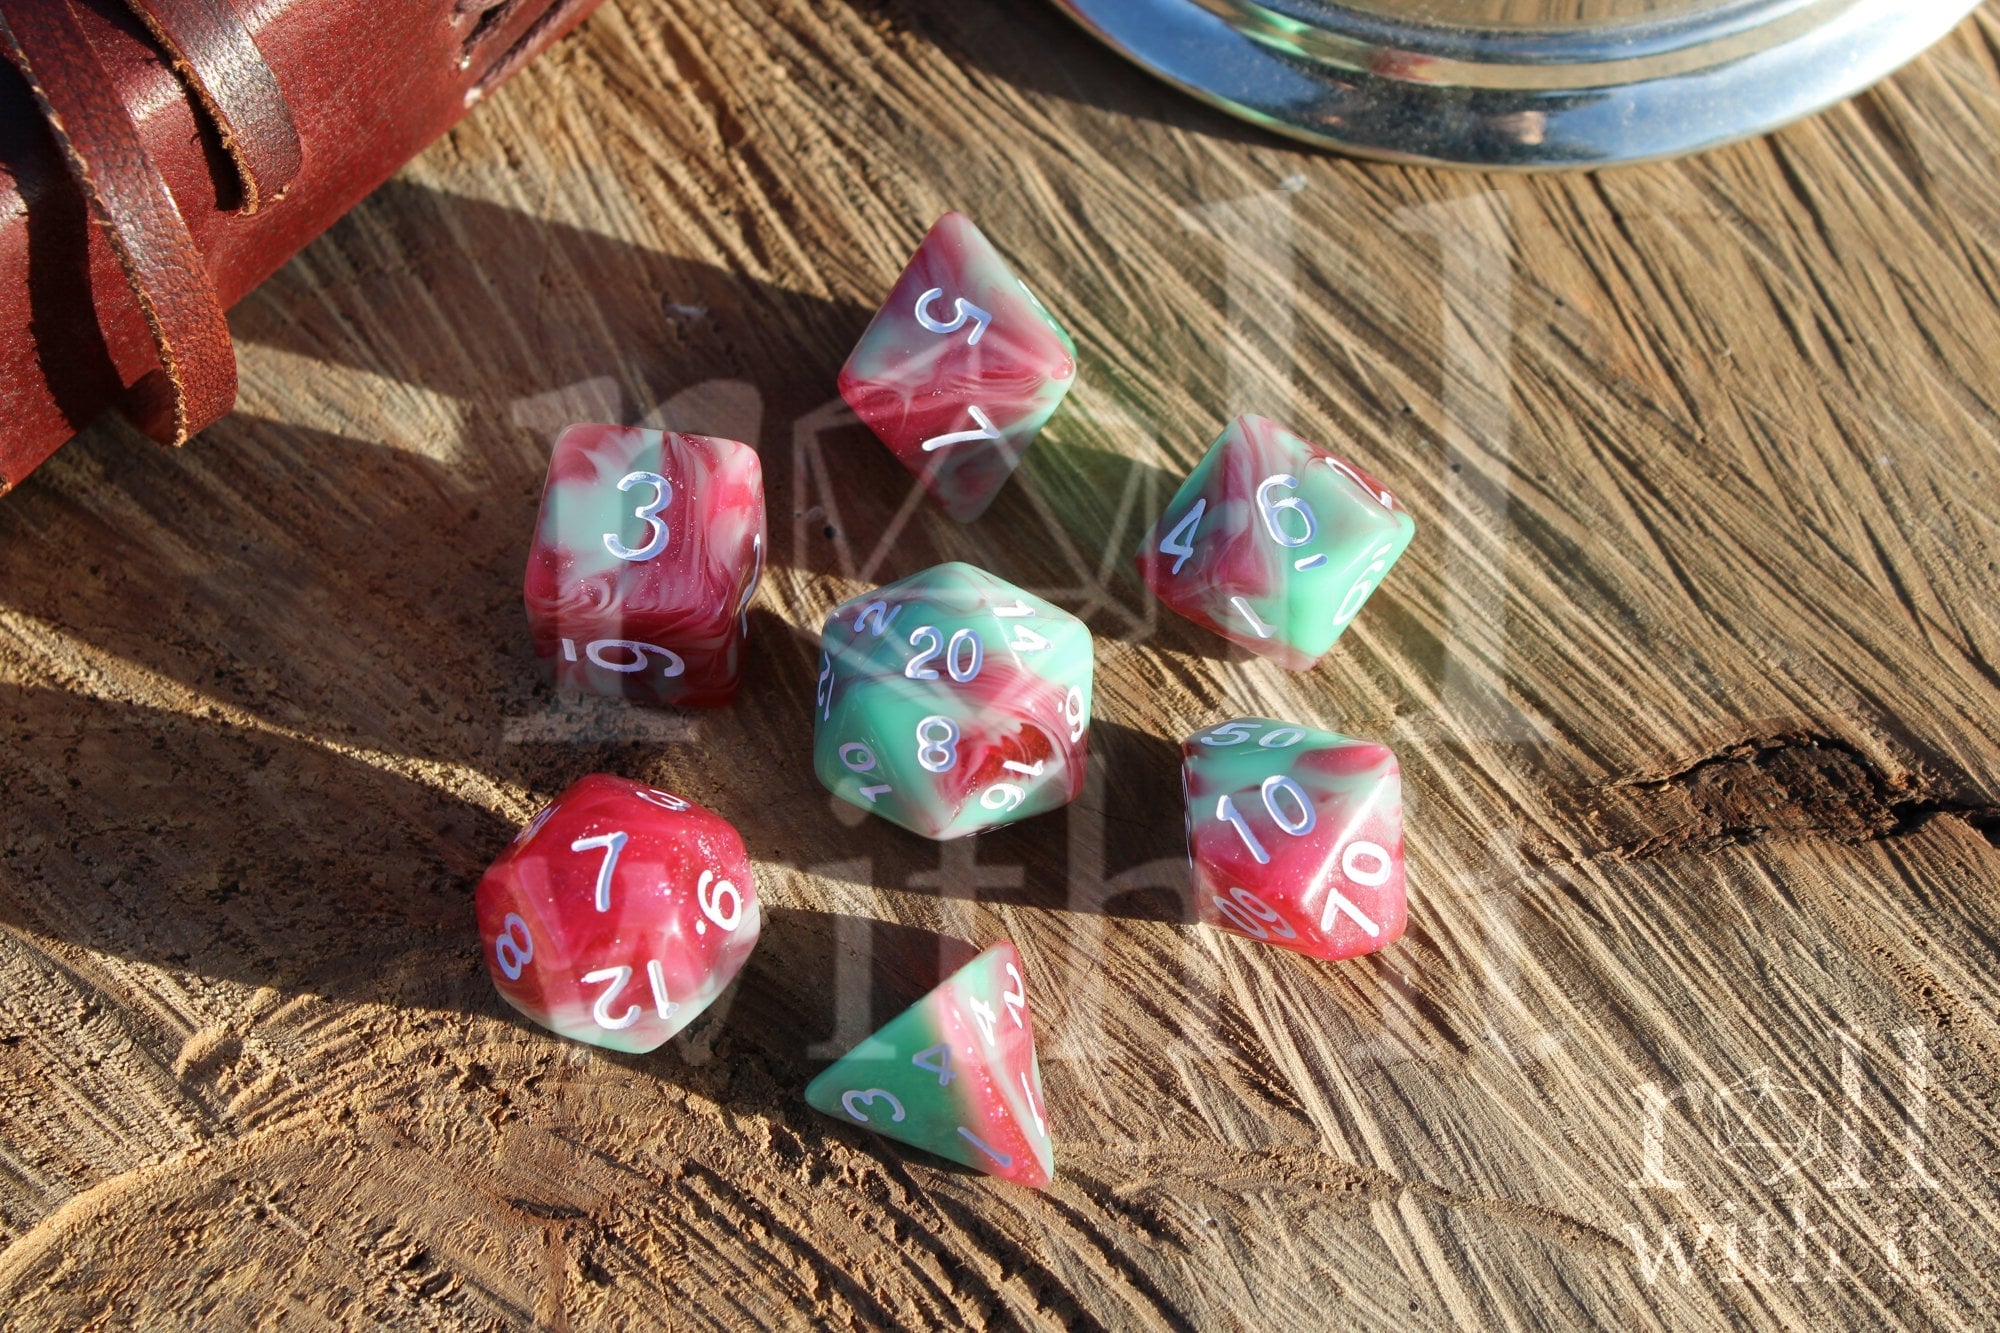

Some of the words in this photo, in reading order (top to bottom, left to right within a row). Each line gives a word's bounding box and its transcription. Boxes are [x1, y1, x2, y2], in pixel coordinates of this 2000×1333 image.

[915, 287, 993, 345] 5
[602, 471, 673, 562] 3
[1160, 498, 1206, 575] 4
[905, 626, 984, 683] 20
[992, 599, 1051, 655] 14
[916, 715, 960, 773] 8
[1200, 722, 1306, 748] 50
[839, 742, 893, 803] 10
[980, 759, 1044, 812] 16
[1216, 775, 1317, 864] 10
[571, 831, 628, 912] 7
[1320, 841, 1392, 938] 70
[495, 911, 534, 981] 8
[580, 959, 680, 1030] 12
[969, 995, 997, 1047] 4
[911, 1042, 957, 1087] 4
[841, 1087, 906, 1122] 3
